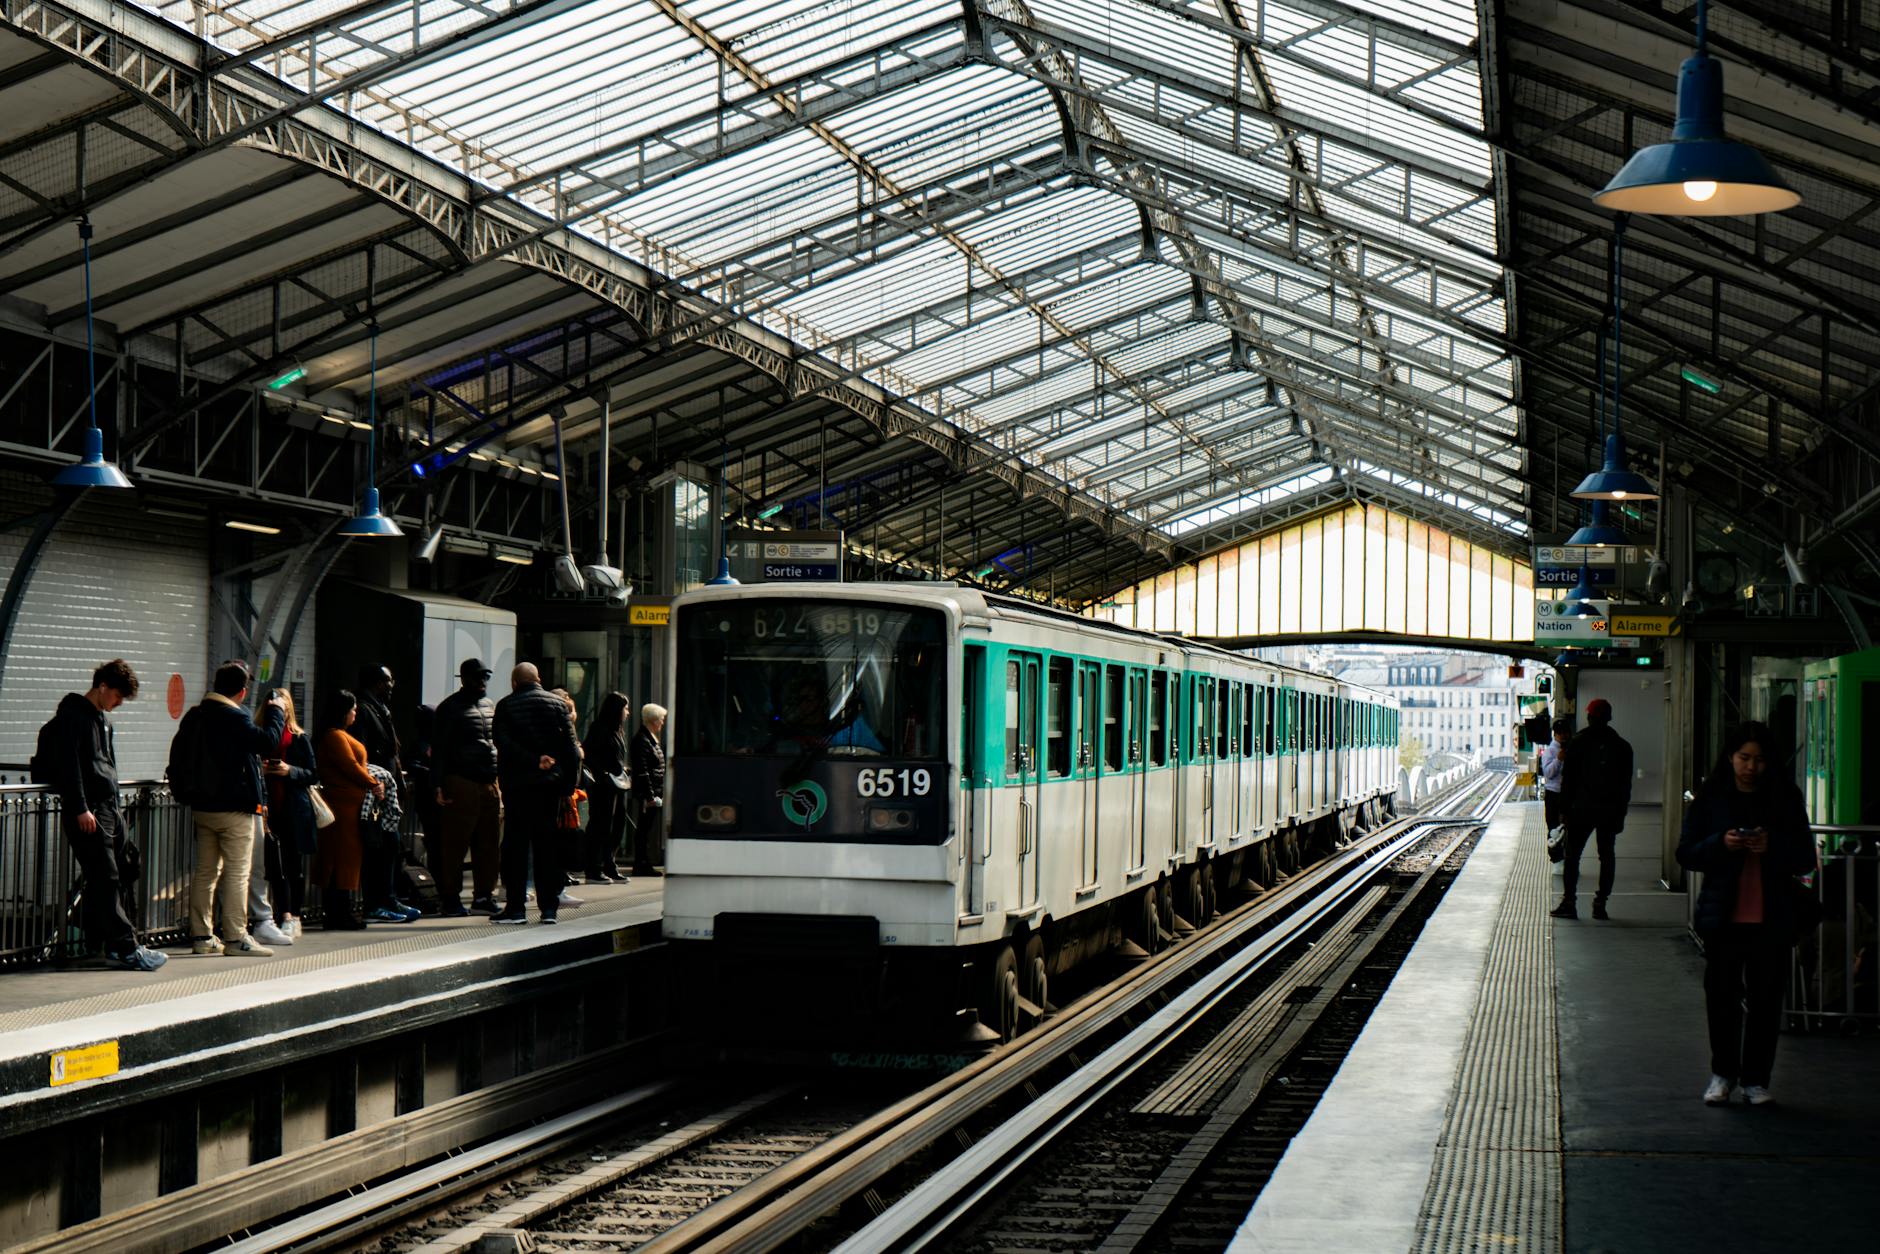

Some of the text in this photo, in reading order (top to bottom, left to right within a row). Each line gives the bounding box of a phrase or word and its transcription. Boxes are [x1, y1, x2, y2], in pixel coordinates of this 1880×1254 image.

[766, 565, 802, 577] Sortie
[817, 568, 822, 576] 2
[1539, 570, 1578, 582] Sortie
[1537, 621, 1572, 631] Nation
[1616, 620, 1662, 632] Alarme
[857, 768, 931, 797] 6519
